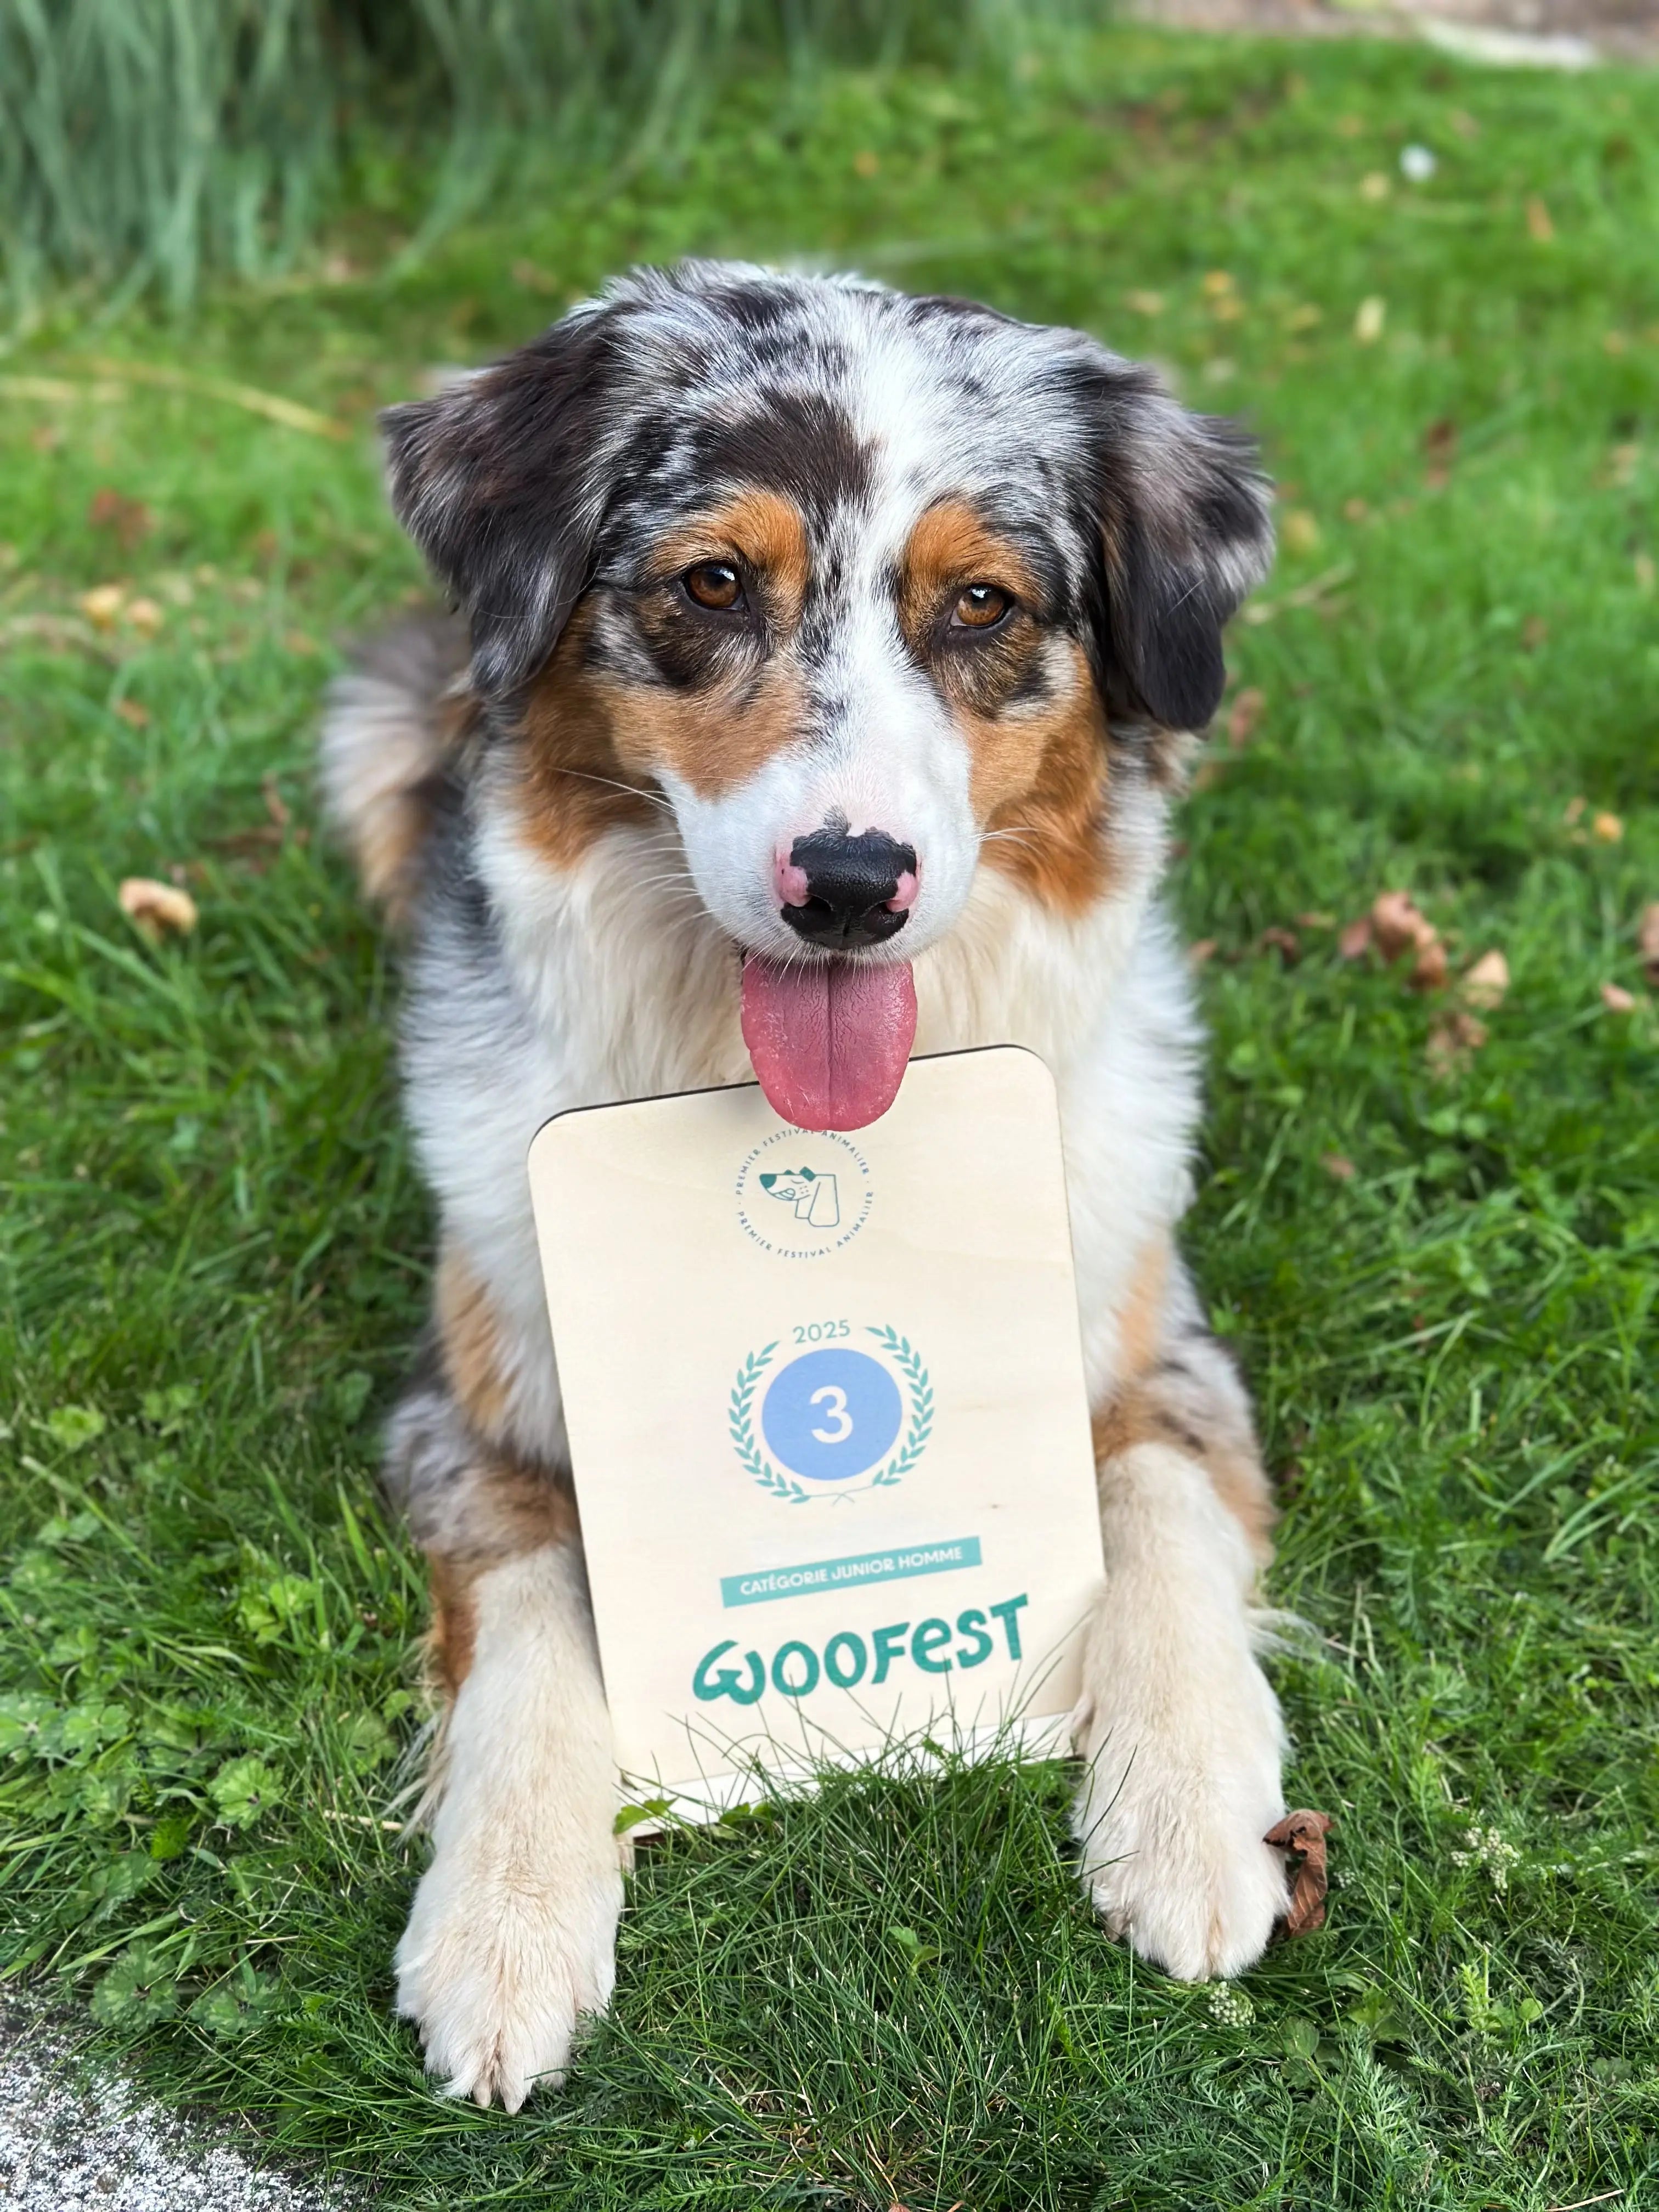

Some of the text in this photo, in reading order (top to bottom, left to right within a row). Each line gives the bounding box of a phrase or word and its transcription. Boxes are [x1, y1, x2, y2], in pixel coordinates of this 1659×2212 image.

[736, 1148, 760, 1195] PREMIER
[821, 1130, 870, 1175] ANIMALIER
[738, 1191, 874, 1259] PREMIER FESTIVAL ANIMALIER
[793, 1319, 850, 1344] 2025
[810, 1386, 853, 1443] 3
[740, 1546, 963, 1595] CATÉGORIE JUNIOR HOMME
